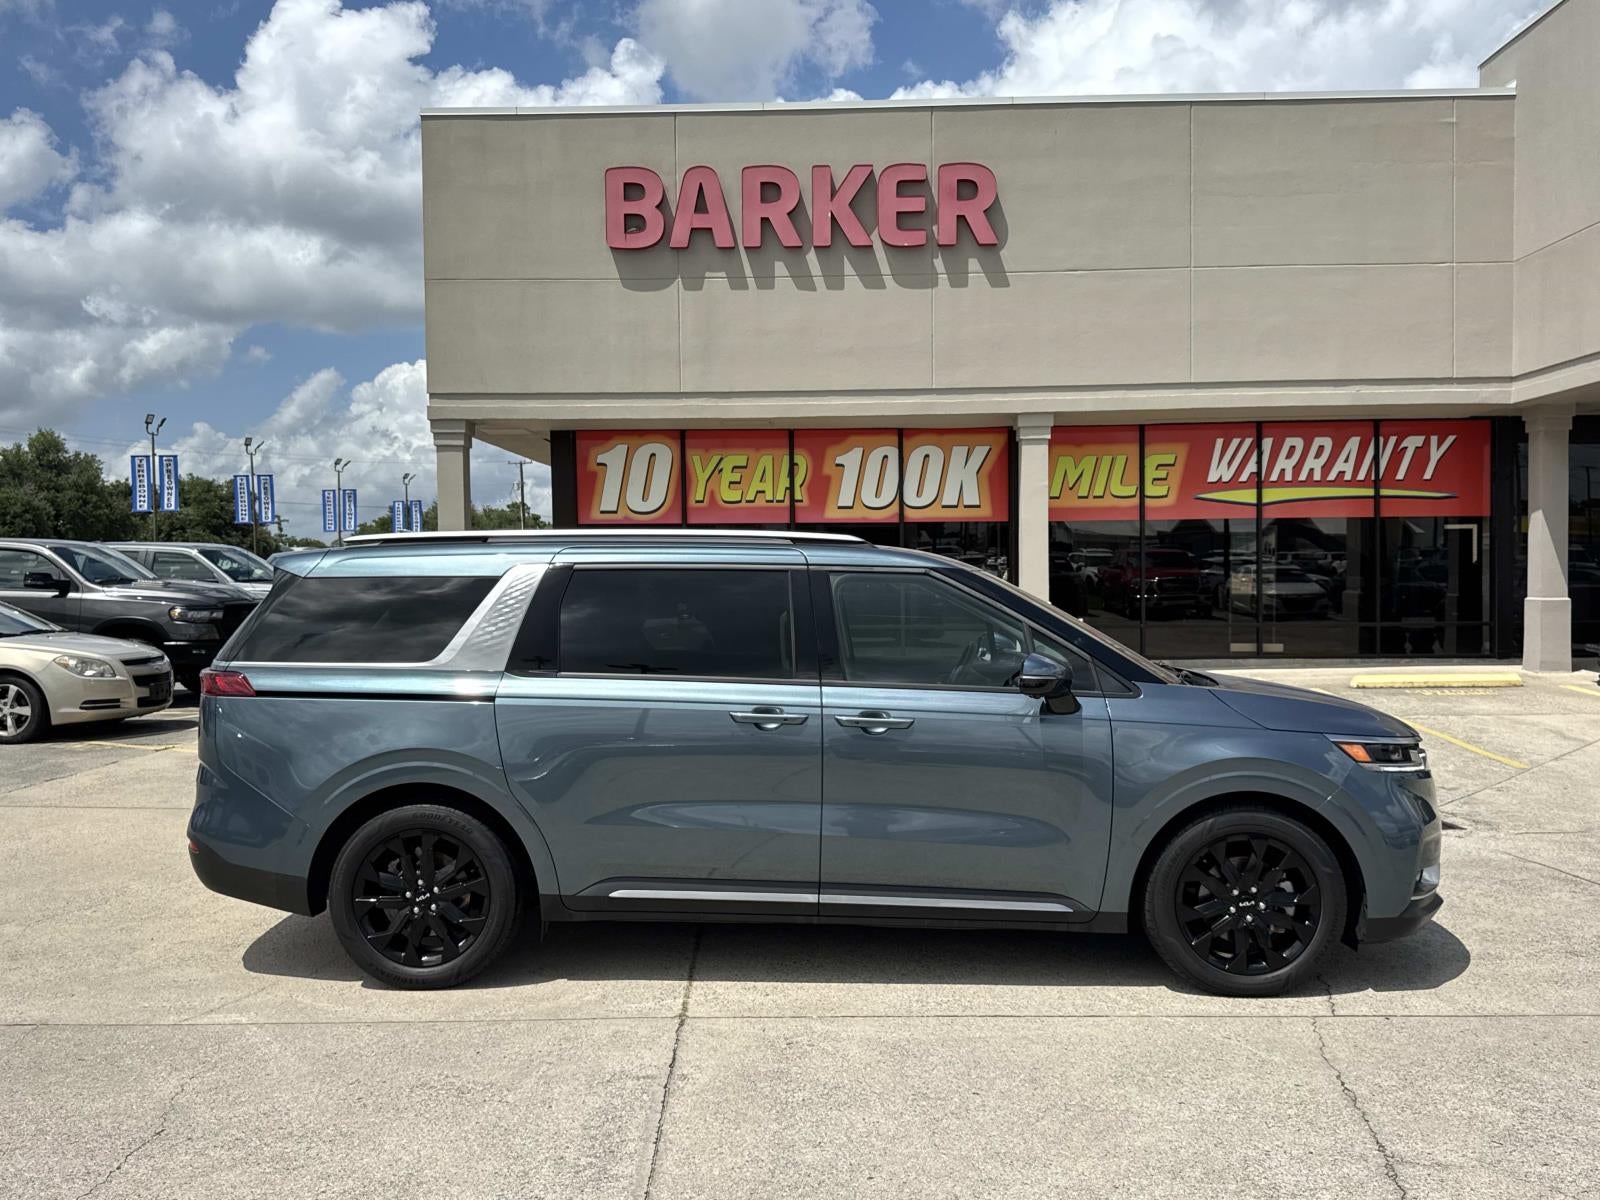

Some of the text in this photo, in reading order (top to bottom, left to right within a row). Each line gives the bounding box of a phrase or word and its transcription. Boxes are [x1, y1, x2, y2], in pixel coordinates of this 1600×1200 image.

[604, 162, 999, 249] BARKER
[137, 458, 146, 508] TERREBONNE
[166, 462, 174, 508] PREOWNED
[596, 434, 1458, 515] 10 YEAR 100K MILE WARRANTY
